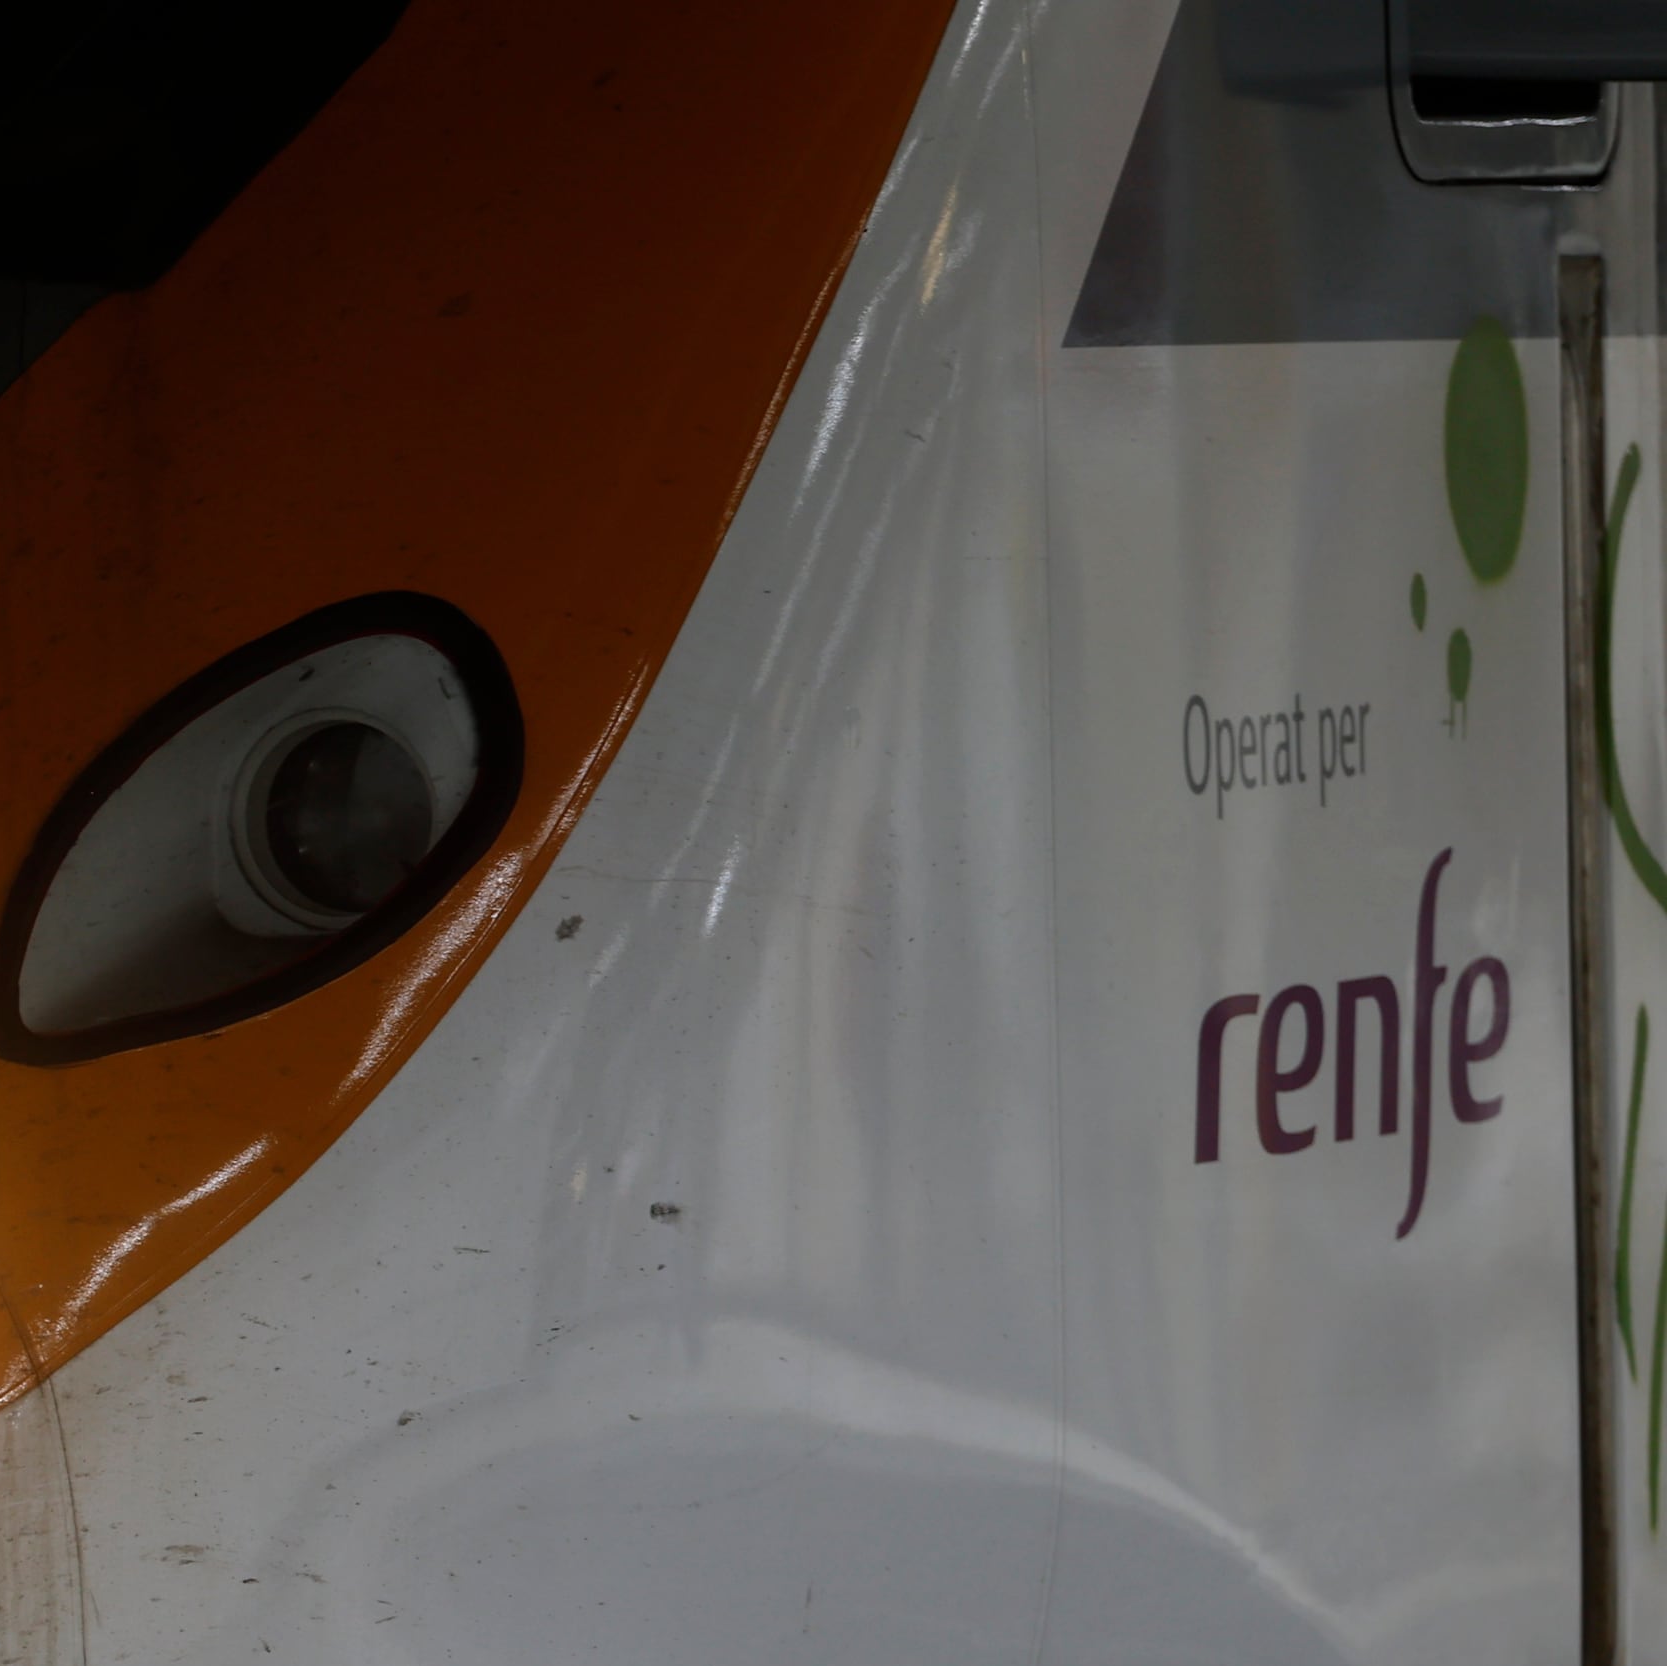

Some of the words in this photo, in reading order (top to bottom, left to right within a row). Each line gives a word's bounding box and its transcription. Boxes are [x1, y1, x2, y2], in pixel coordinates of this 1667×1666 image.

[1183, 694, 1308, 819] Operat
[1318, 702, 1370, 807] per
[1193, 847, 1510, 1241] renfe
